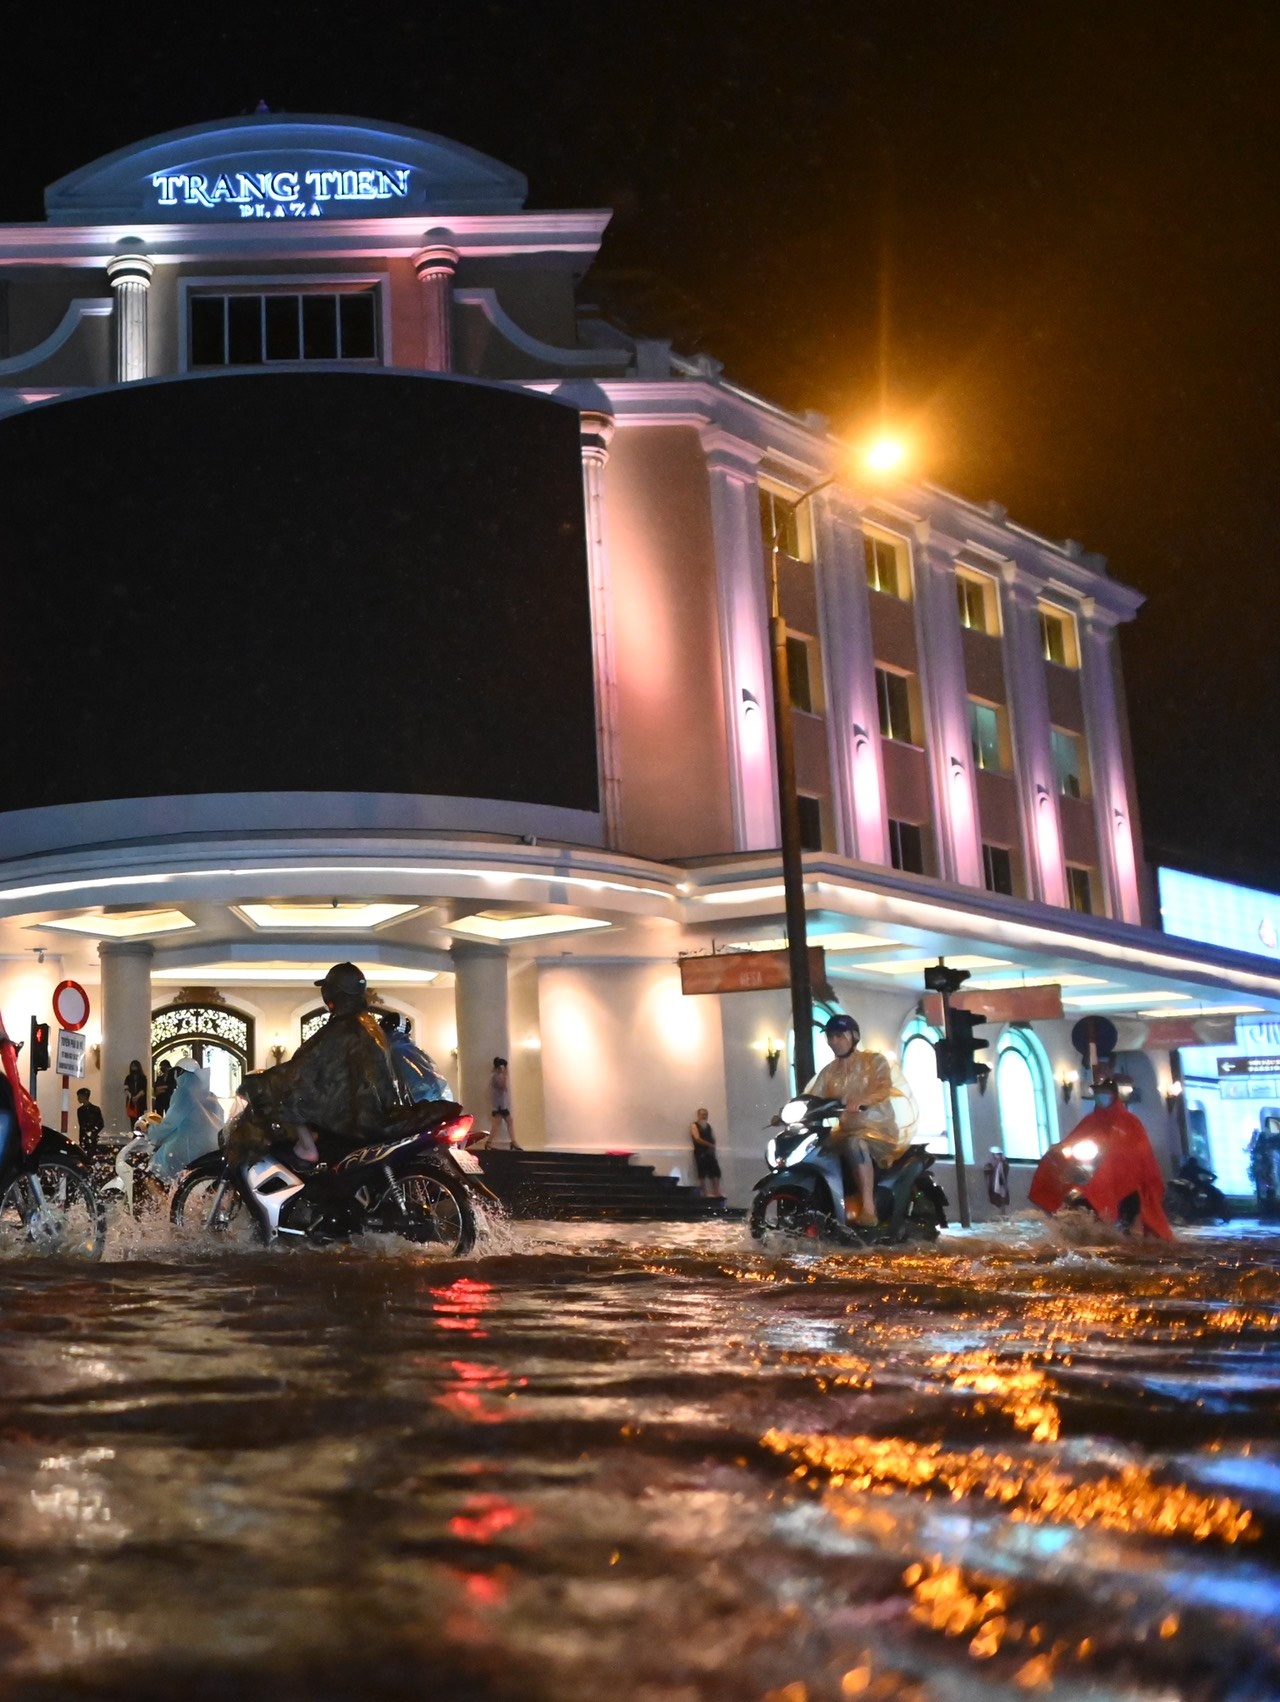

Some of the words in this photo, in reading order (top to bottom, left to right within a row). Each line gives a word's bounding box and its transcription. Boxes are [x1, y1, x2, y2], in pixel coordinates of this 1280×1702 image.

[152, 171, 300, 208] TRANG
[305, 169, 410, 201] TIEN
[239, 202, 323, 218] PLAZA
